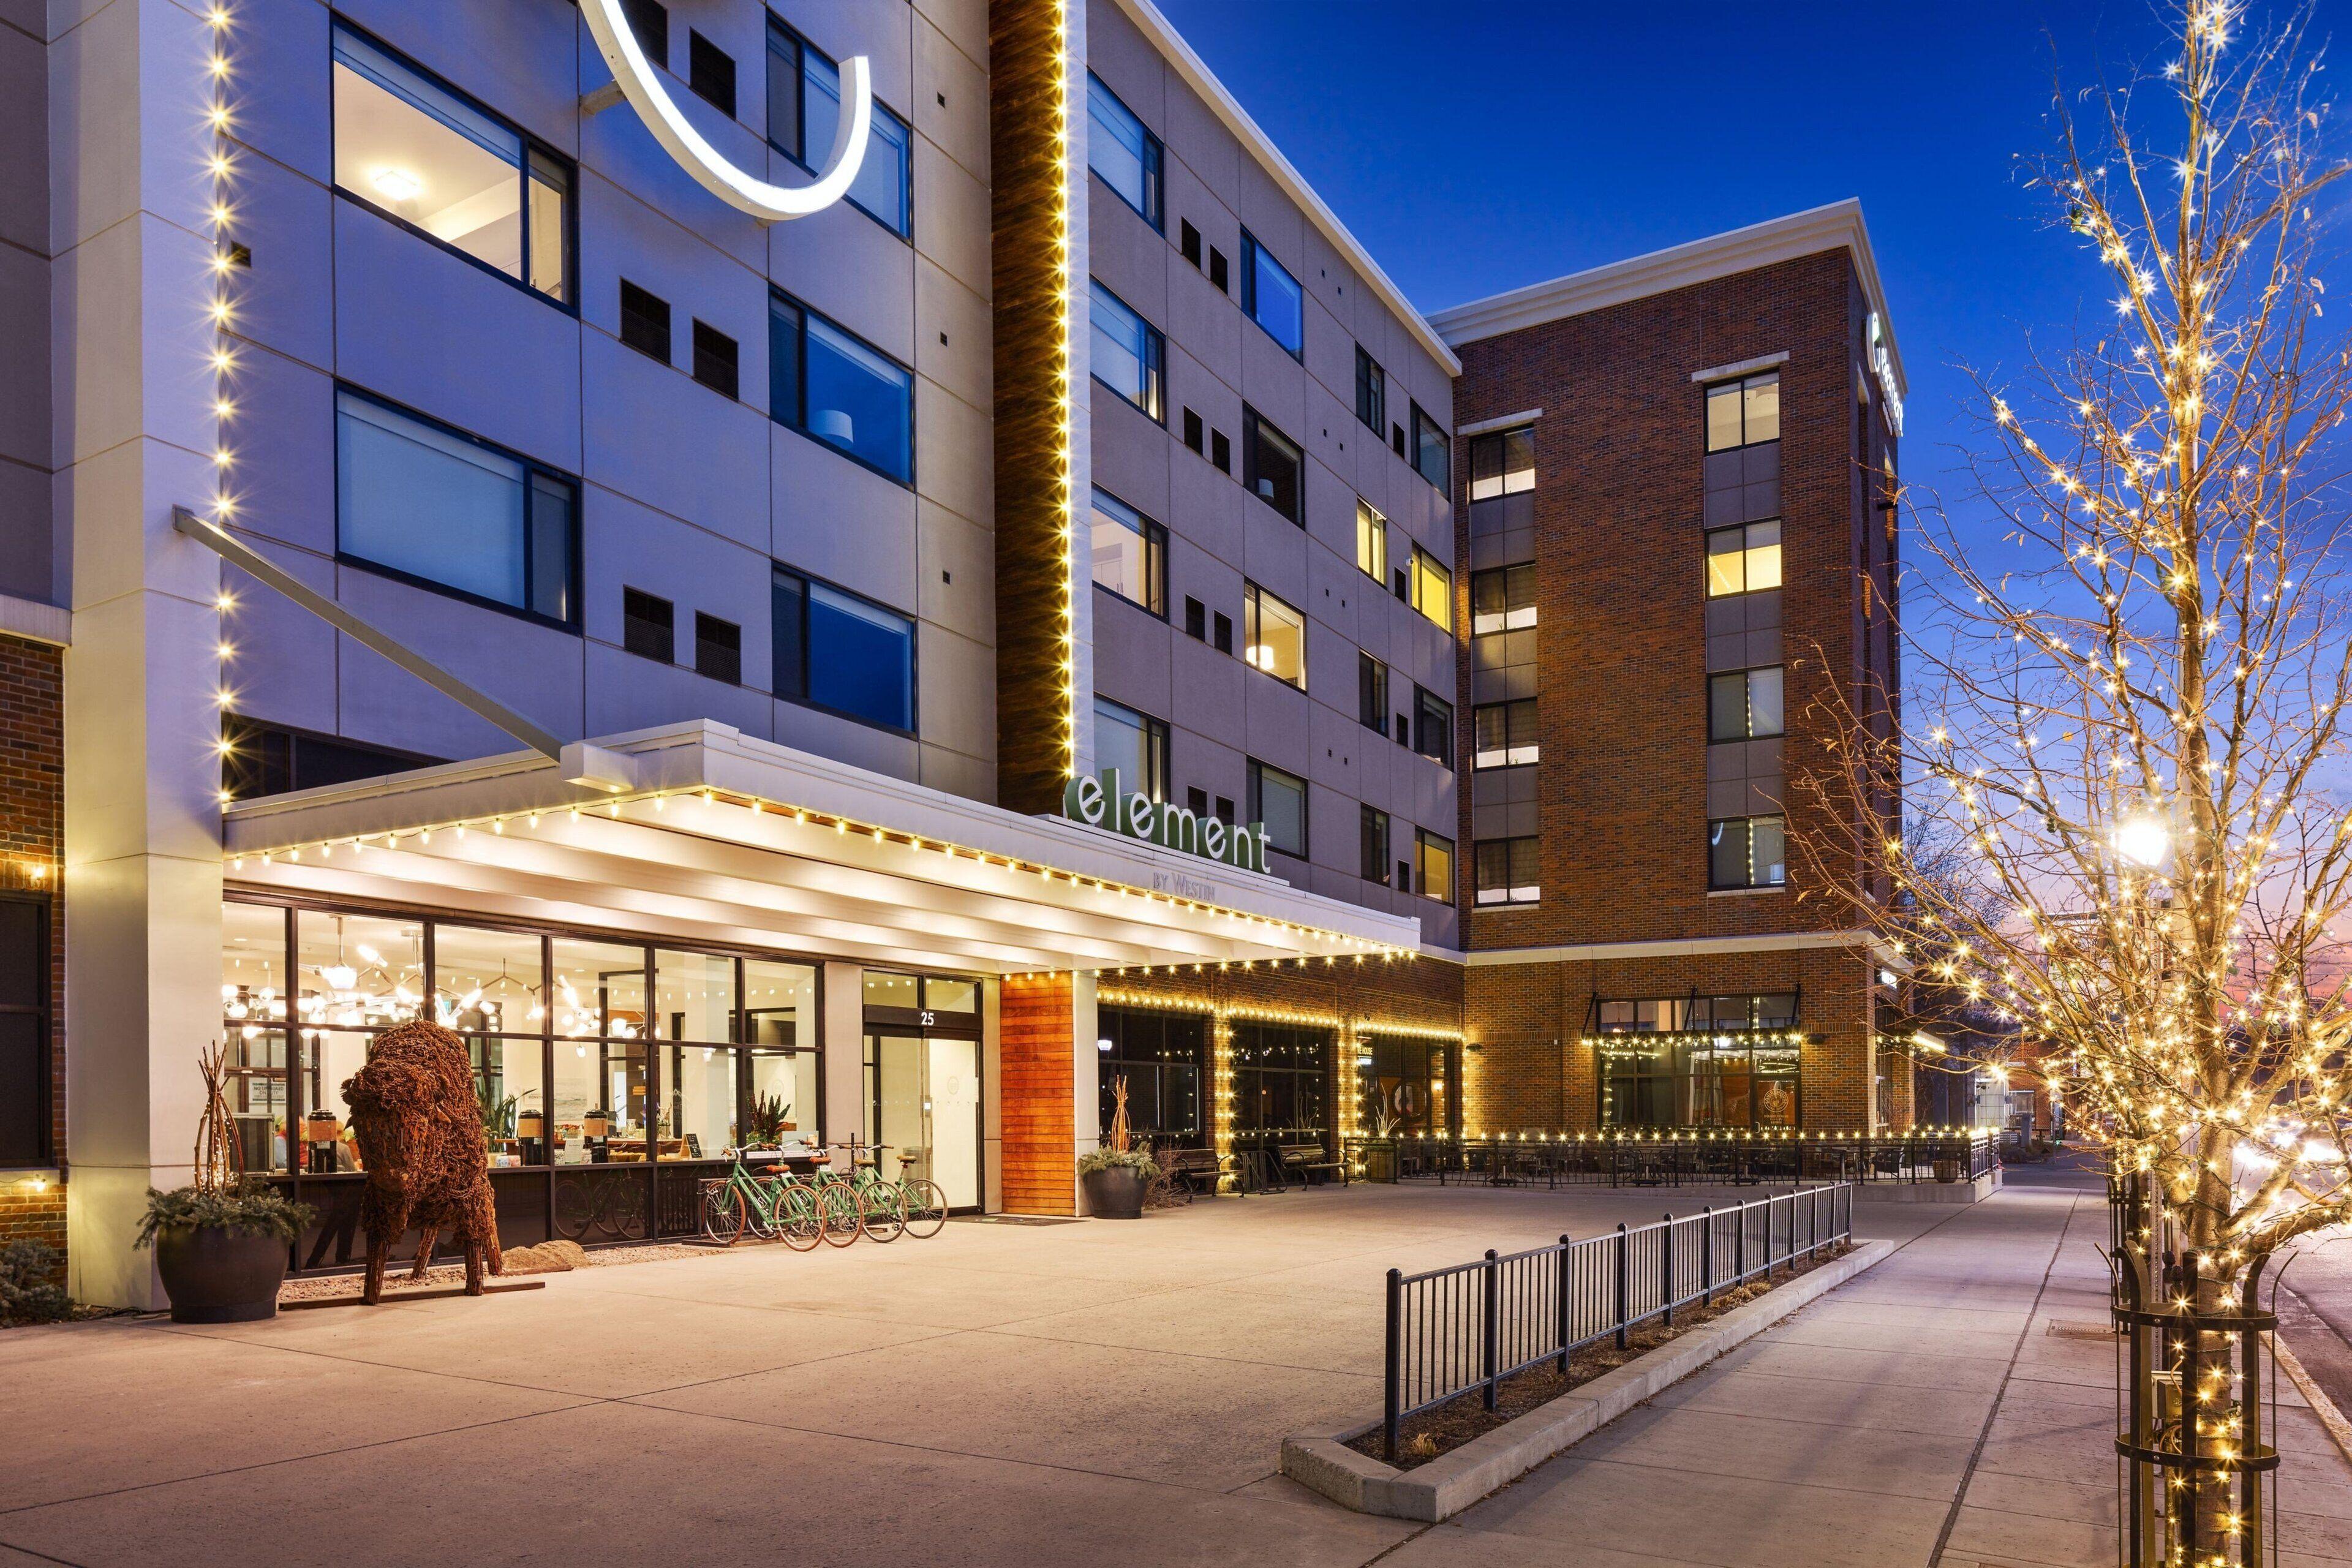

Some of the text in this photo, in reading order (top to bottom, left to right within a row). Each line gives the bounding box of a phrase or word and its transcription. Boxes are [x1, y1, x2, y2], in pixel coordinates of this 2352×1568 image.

[1067, 767, 1271, 874] element
[1153, 872, 1169, 890] BY
[921, 1011, 935, 1026] 25
